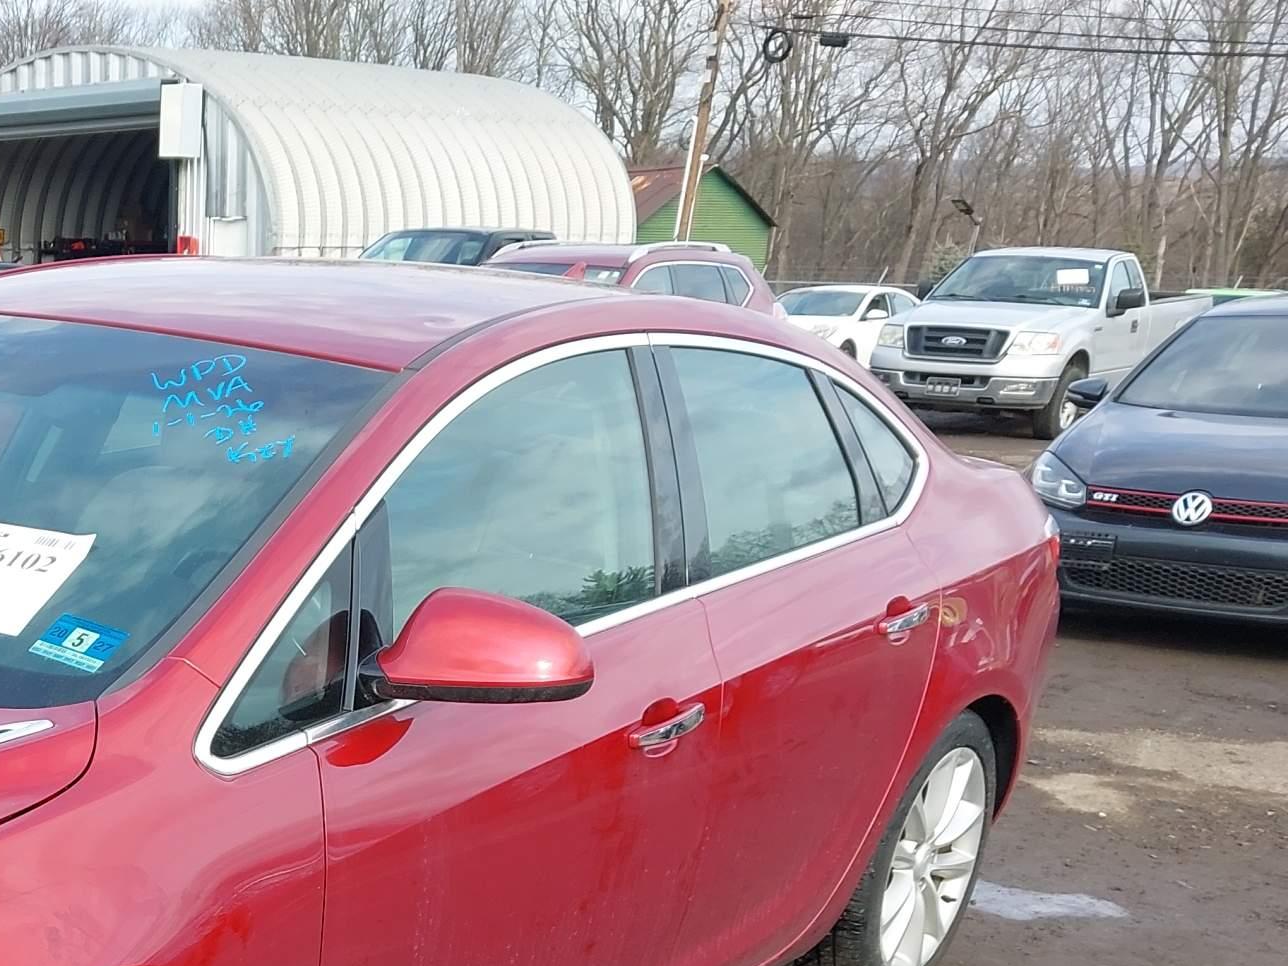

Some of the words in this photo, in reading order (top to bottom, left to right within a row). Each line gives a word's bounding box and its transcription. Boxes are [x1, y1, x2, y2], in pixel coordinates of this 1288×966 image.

[150, 354, 247, 390] WPD
[1092, 491, 1120, 502] GTI
[50, 626, 69, 639] 20
[71, 632, 88, 648] 5
[93, 640, 114, 652] 27
